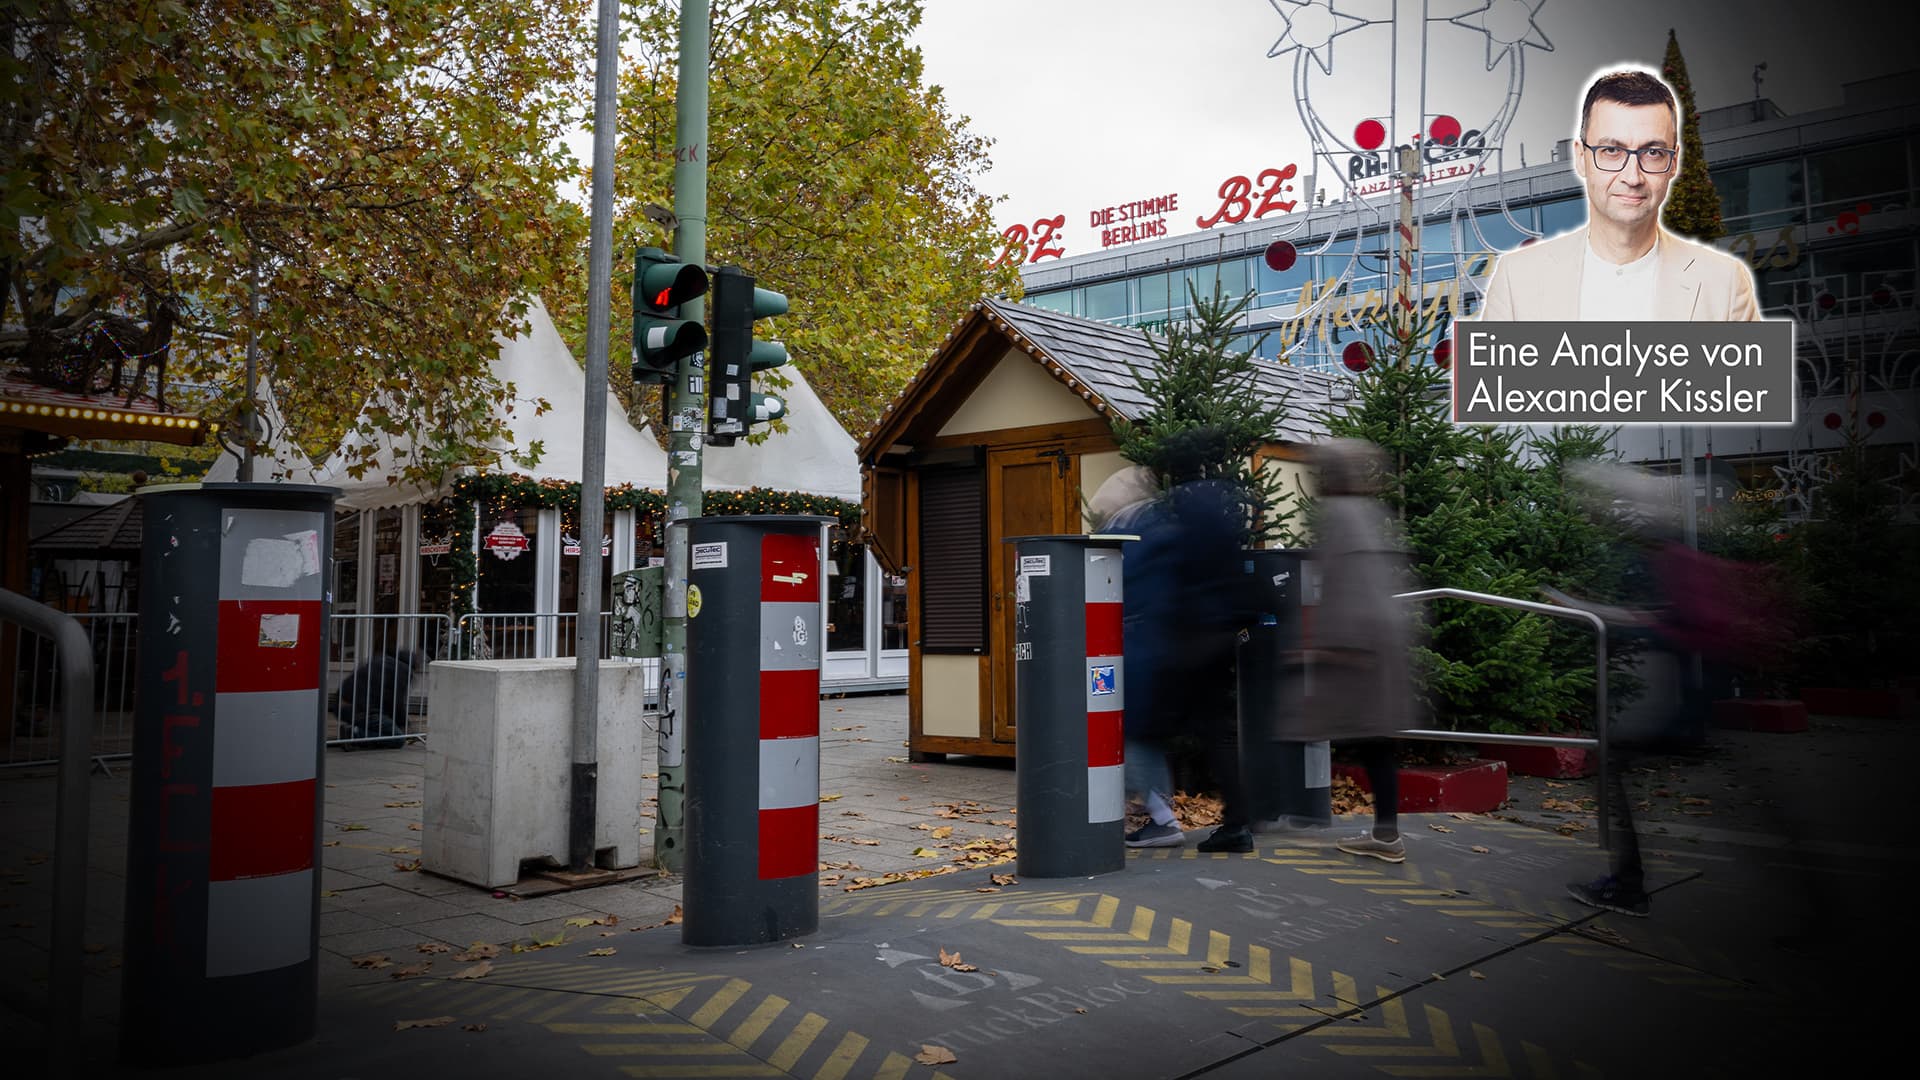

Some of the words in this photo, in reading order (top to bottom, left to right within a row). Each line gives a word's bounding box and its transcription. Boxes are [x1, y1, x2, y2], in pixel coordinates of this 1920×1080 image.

[1090, 206, 1116, 228] DIE
[1118, 193, 1179, 221] STIMME
[1101, 218, 1168, 248] BERLINS
